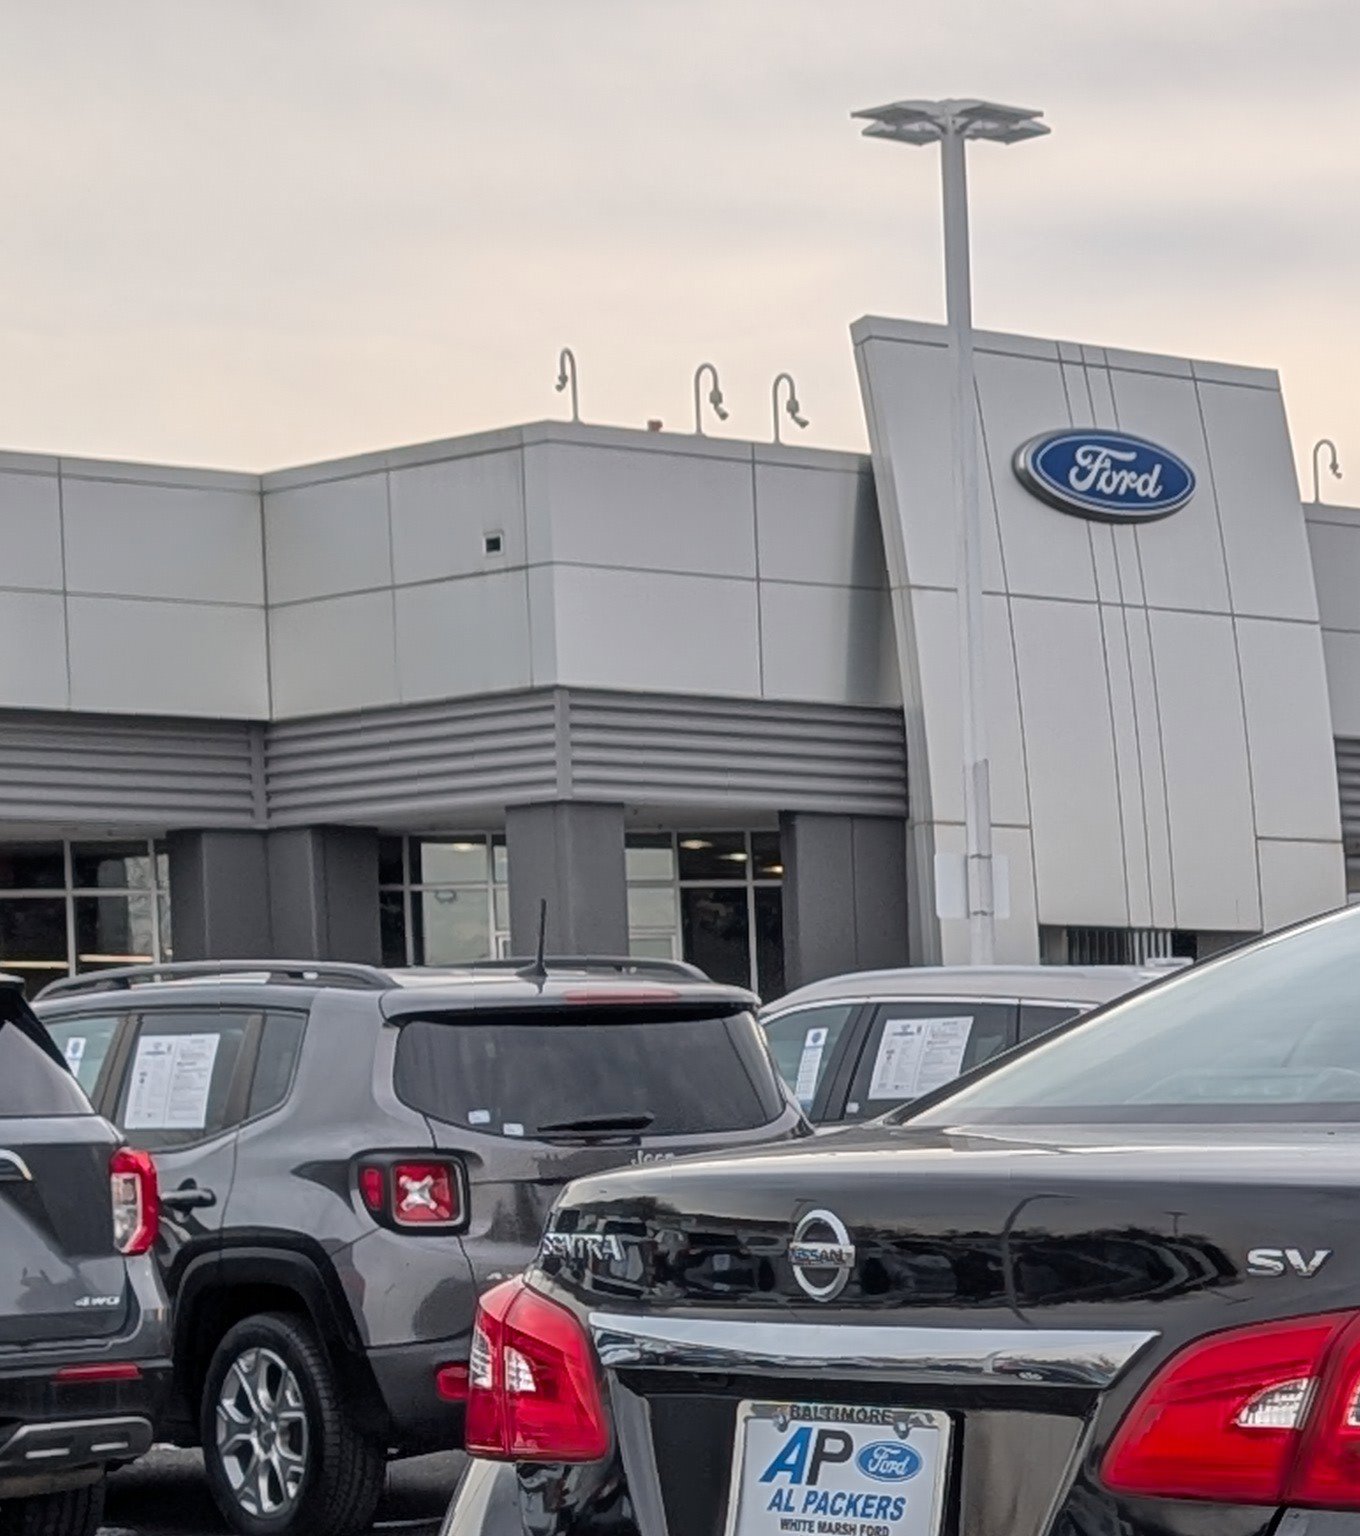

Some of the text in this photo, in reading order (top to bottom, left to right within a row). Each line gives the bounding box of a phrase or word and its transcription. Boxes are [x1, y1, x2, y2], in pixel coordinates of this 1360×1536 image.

[1069, 444, 1163, 499] Ford
[1246, 1248, 1333, 1277] SV
[75, 1296, 120, 1306] 4WD
[790, 1404, 893, 1424] BALTIMORE
[759, 1426, 854, 1487] AP
[868, 1446, 911, 1475] Ford
[767, 1488, 907, 1521] AL PACKERS
[780, 1518, 815, 1533] WHITE
[817, 1521, 858, 1536] MARSH
